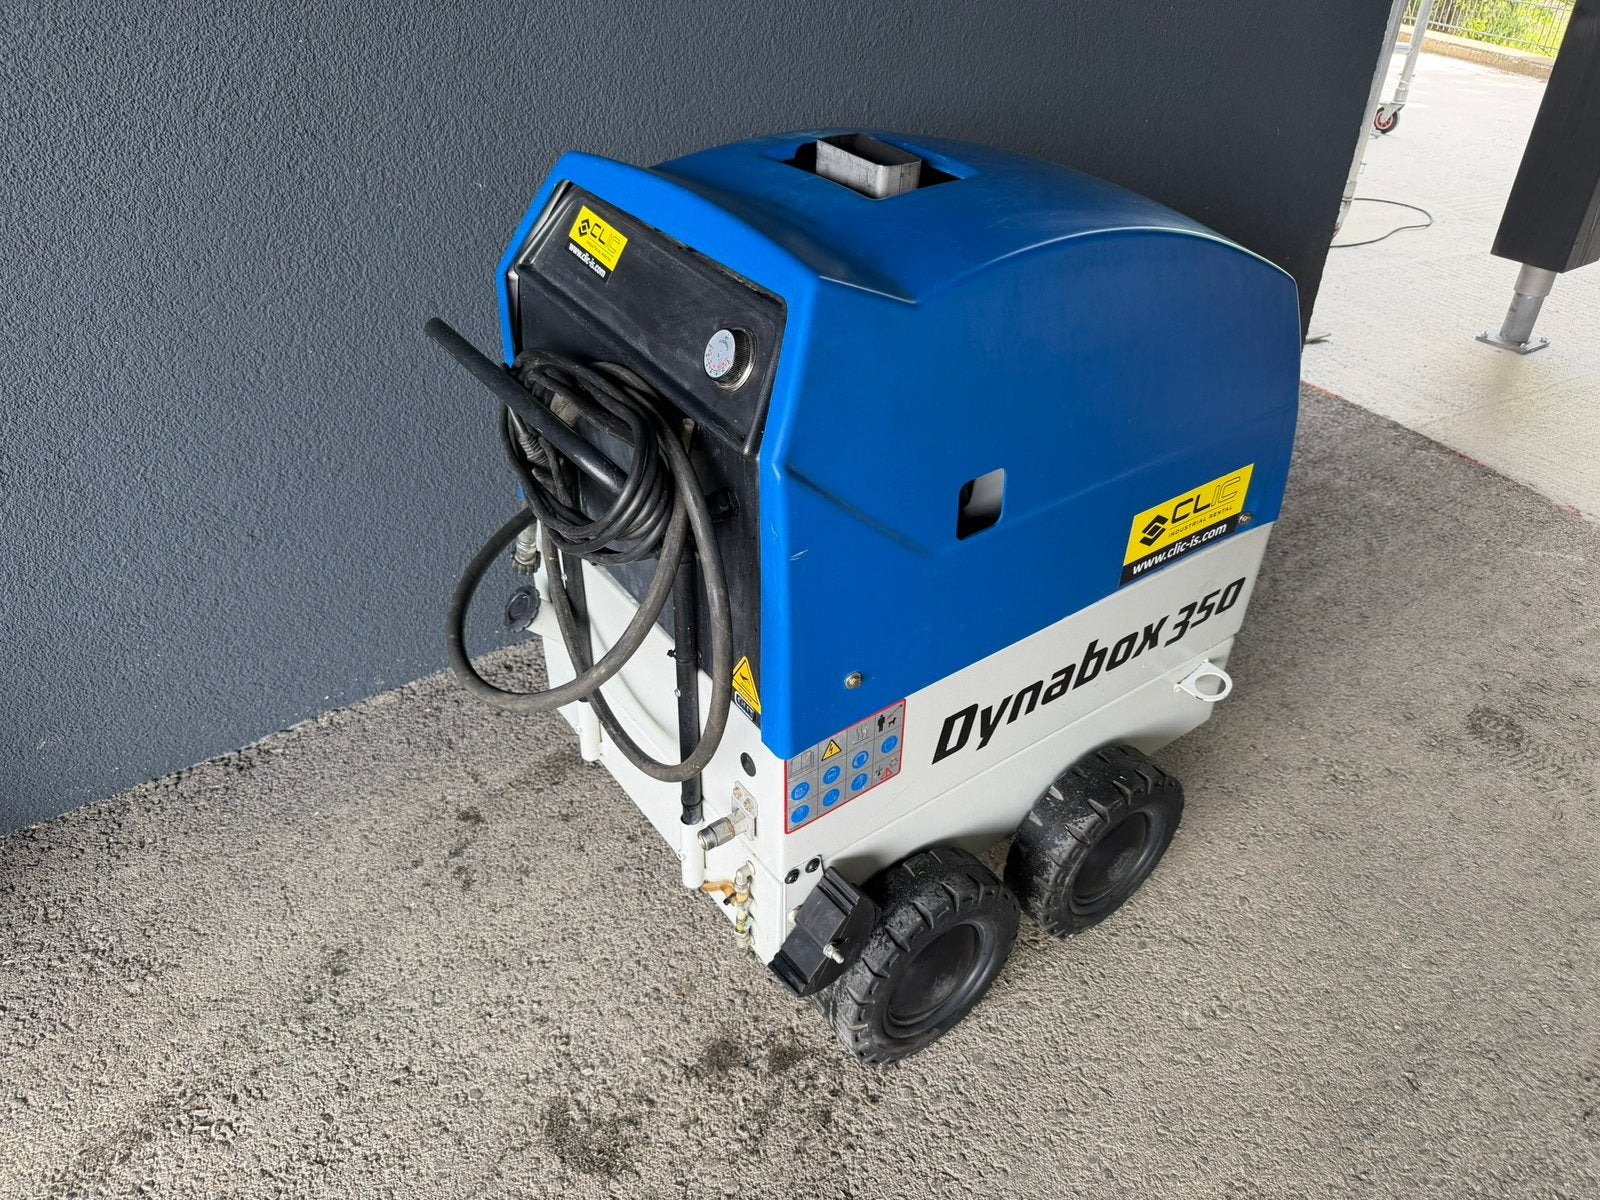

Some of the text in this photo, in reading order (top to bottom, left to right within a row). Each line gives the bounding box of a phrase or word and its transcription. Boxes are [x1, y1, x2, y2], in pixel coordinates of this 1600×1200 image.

[569, 243, 606, 278] www.clic-is.com
[1168, 505, 1233, 538] INDUSTRIAL RENTAL
[1171, 476, 1241, 524] CLIC
[1132, 523, 1228, 575] www.clic-is.com
[931, 576, 1246, 765] Dynabox 350
